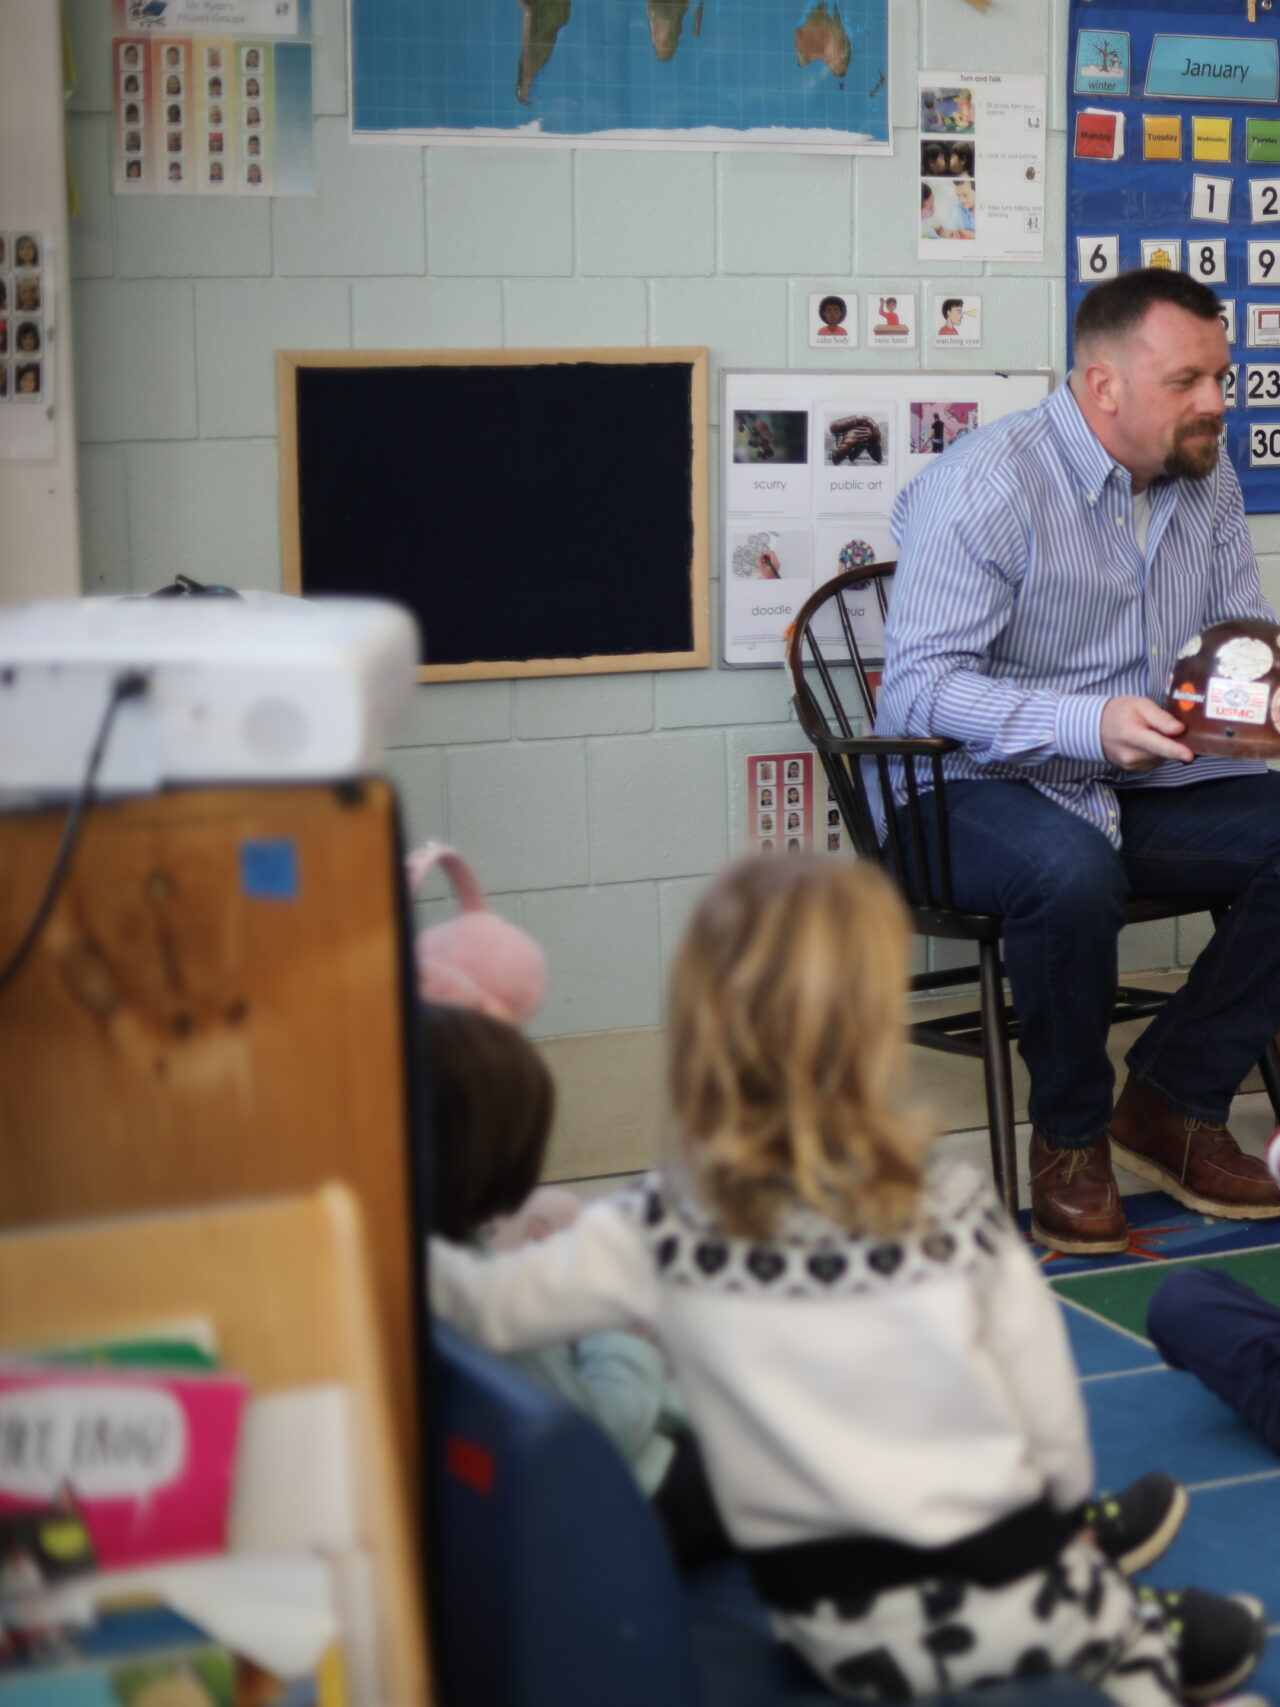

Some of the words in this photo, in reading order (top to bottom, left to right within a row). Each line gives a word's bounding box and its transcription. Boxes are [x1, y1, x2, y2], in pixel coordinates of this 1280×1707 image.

[1180, 58, 1250, 84] January
[1088, 81, 1117, 91] winter
[1081, 131, 1111, 143] Monday
[1147, 133, 1178, 143] Tuesday
[1206, 184, 1216, 213] 1
[1262, 186, 1278, 216] 2
[1089, 244, 1107, 274] 6
[1199, 246, 1216, 275] 8
[1258, 249, 1276, 278] 9
[816, 335, 833, 344] calm
[833, 335, 850, 346] body
[874, 336, 891, 344] raise
[891, 335, 908, 344] hand
[935, 336, 964, 346] watching
[753, 479, 788, 492] scurry
[830, 479, 864, 492] public
[867, 479, 882, 490] art
[751, 604, 792, 616] doodle
[1215, 706, 1255, 719] USMC
